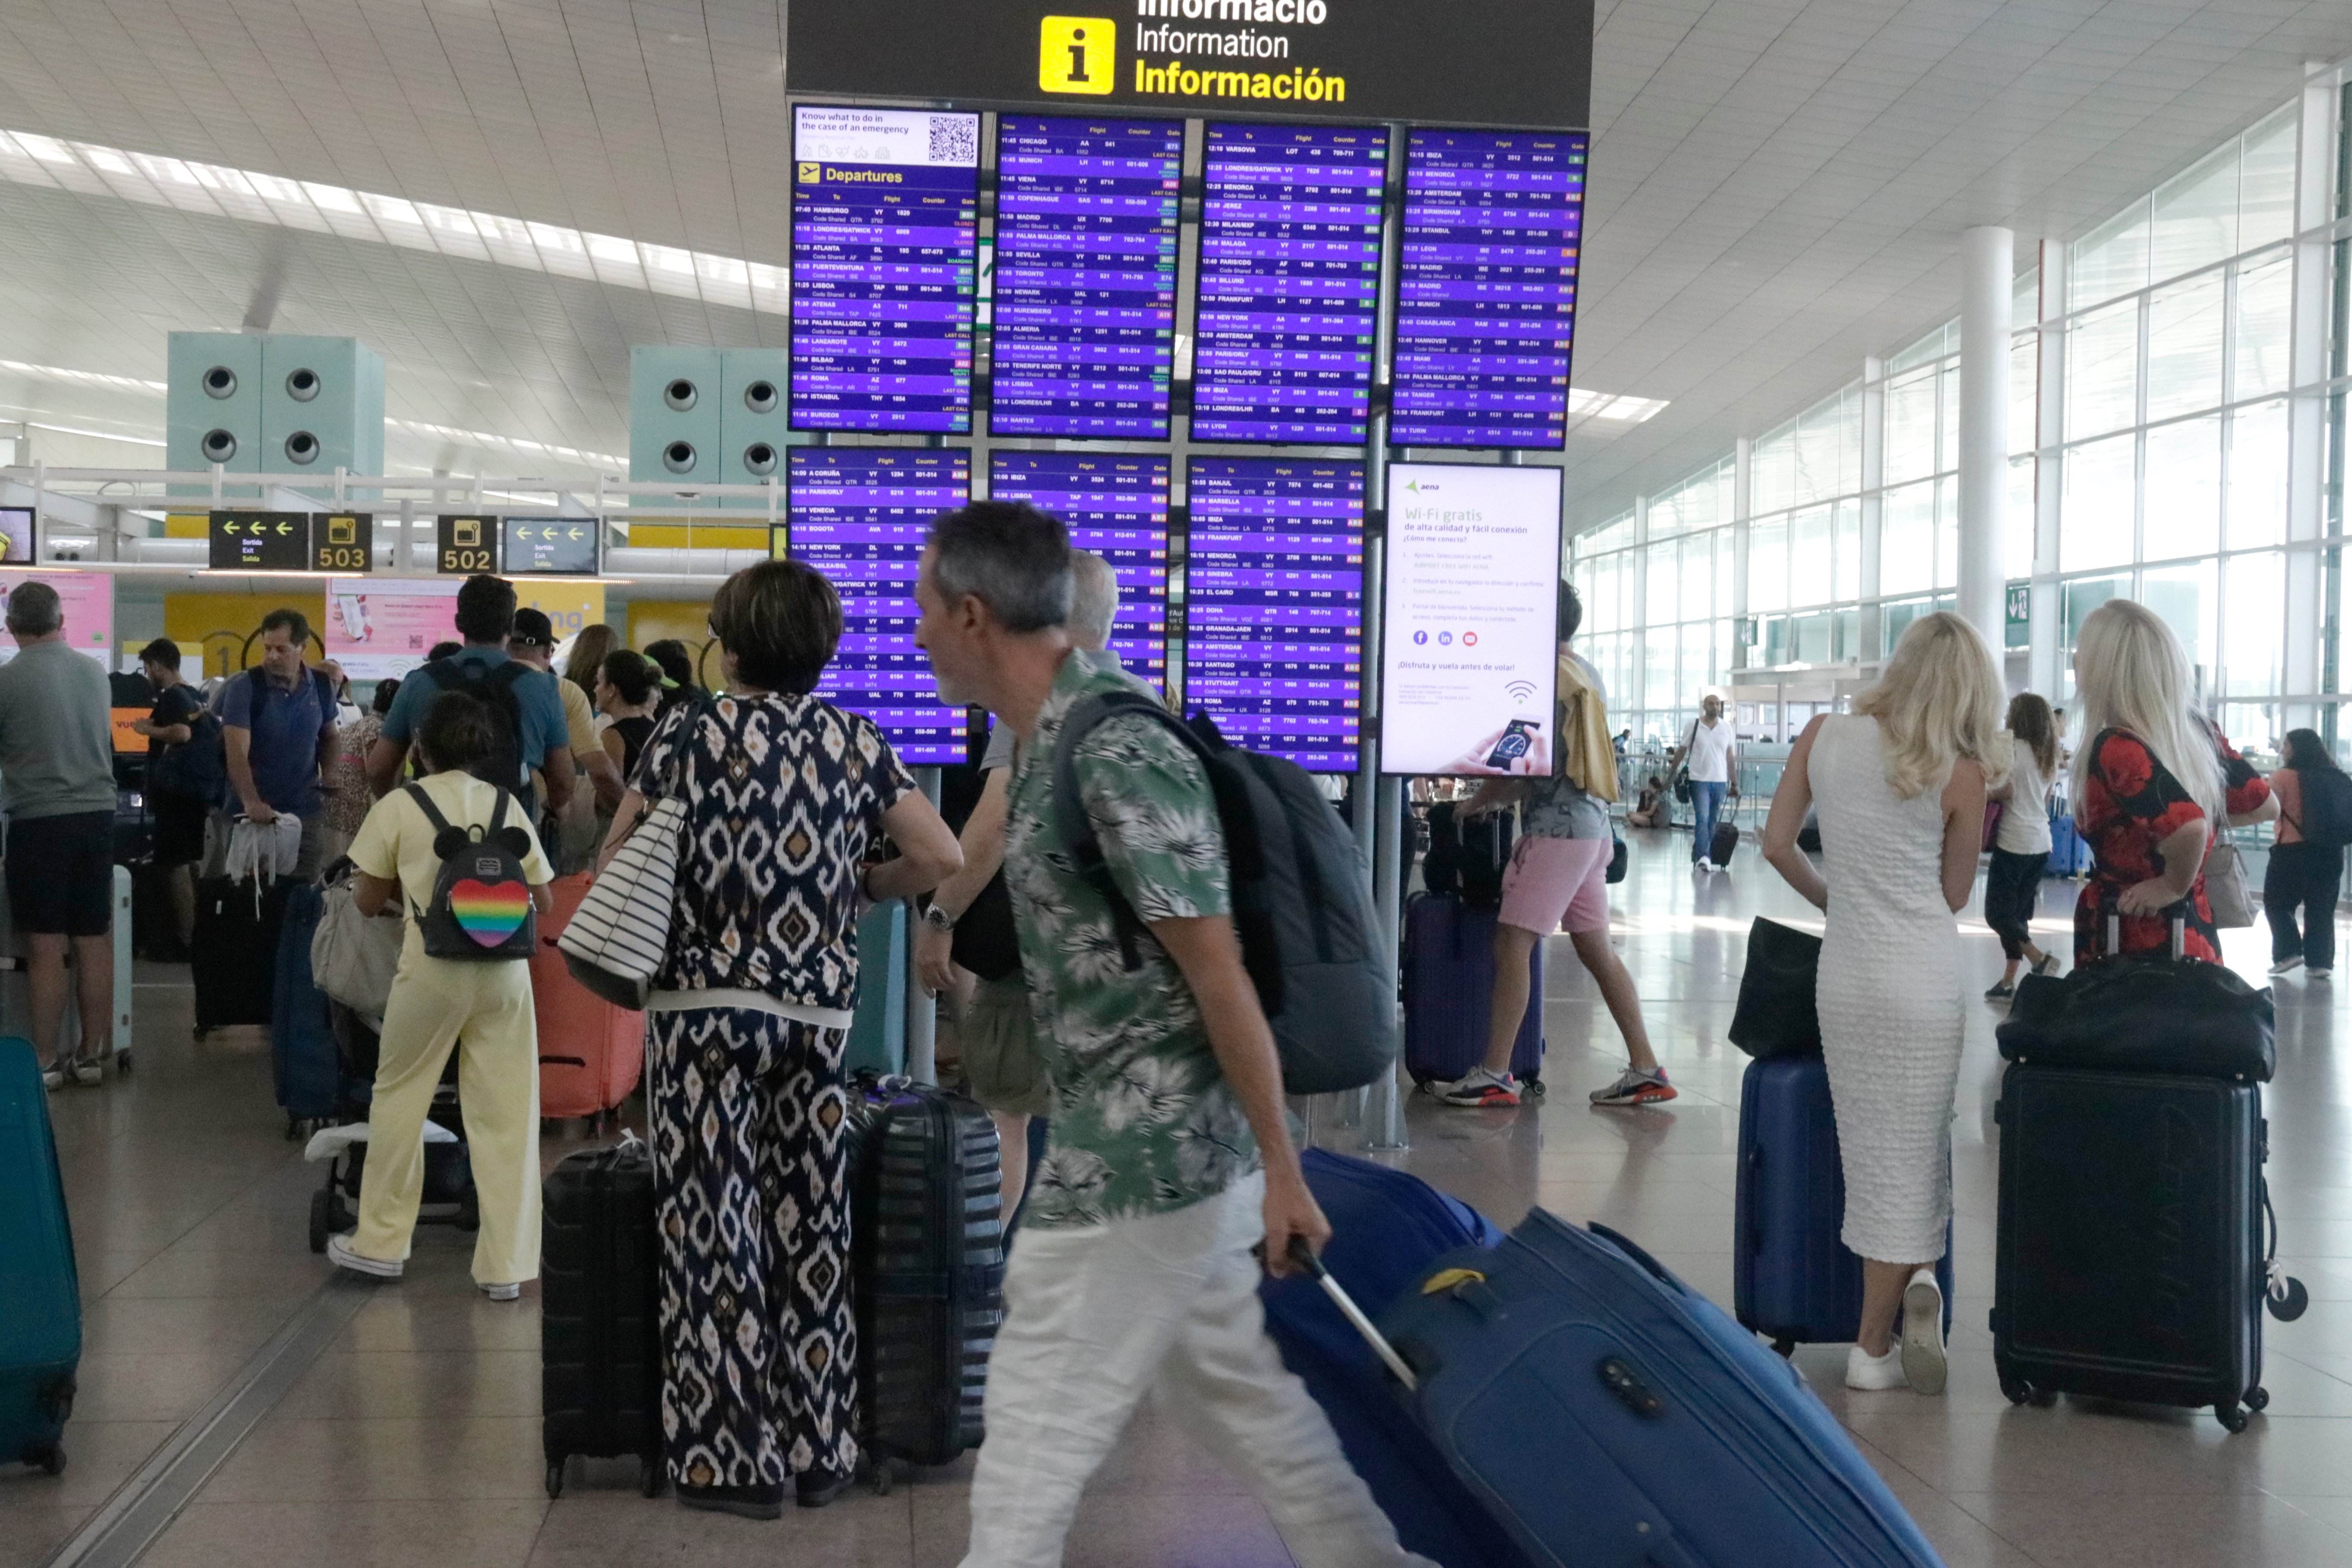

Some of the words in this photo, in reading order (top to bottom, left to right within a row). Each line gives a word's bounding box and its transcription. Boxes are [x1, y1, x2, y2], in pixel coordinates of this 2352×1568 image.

[1137, 23, 1288, 58] Information
[1136, 59, 1344, 101] Información
[826, 168, 902, 182] Departures
[1406, 508, 1438, 519] Wi-Fi
[1443, 510, 1482, 523] gratis
[320, 549, 364, 567] 503
[445, 551, 489, 569] 502
